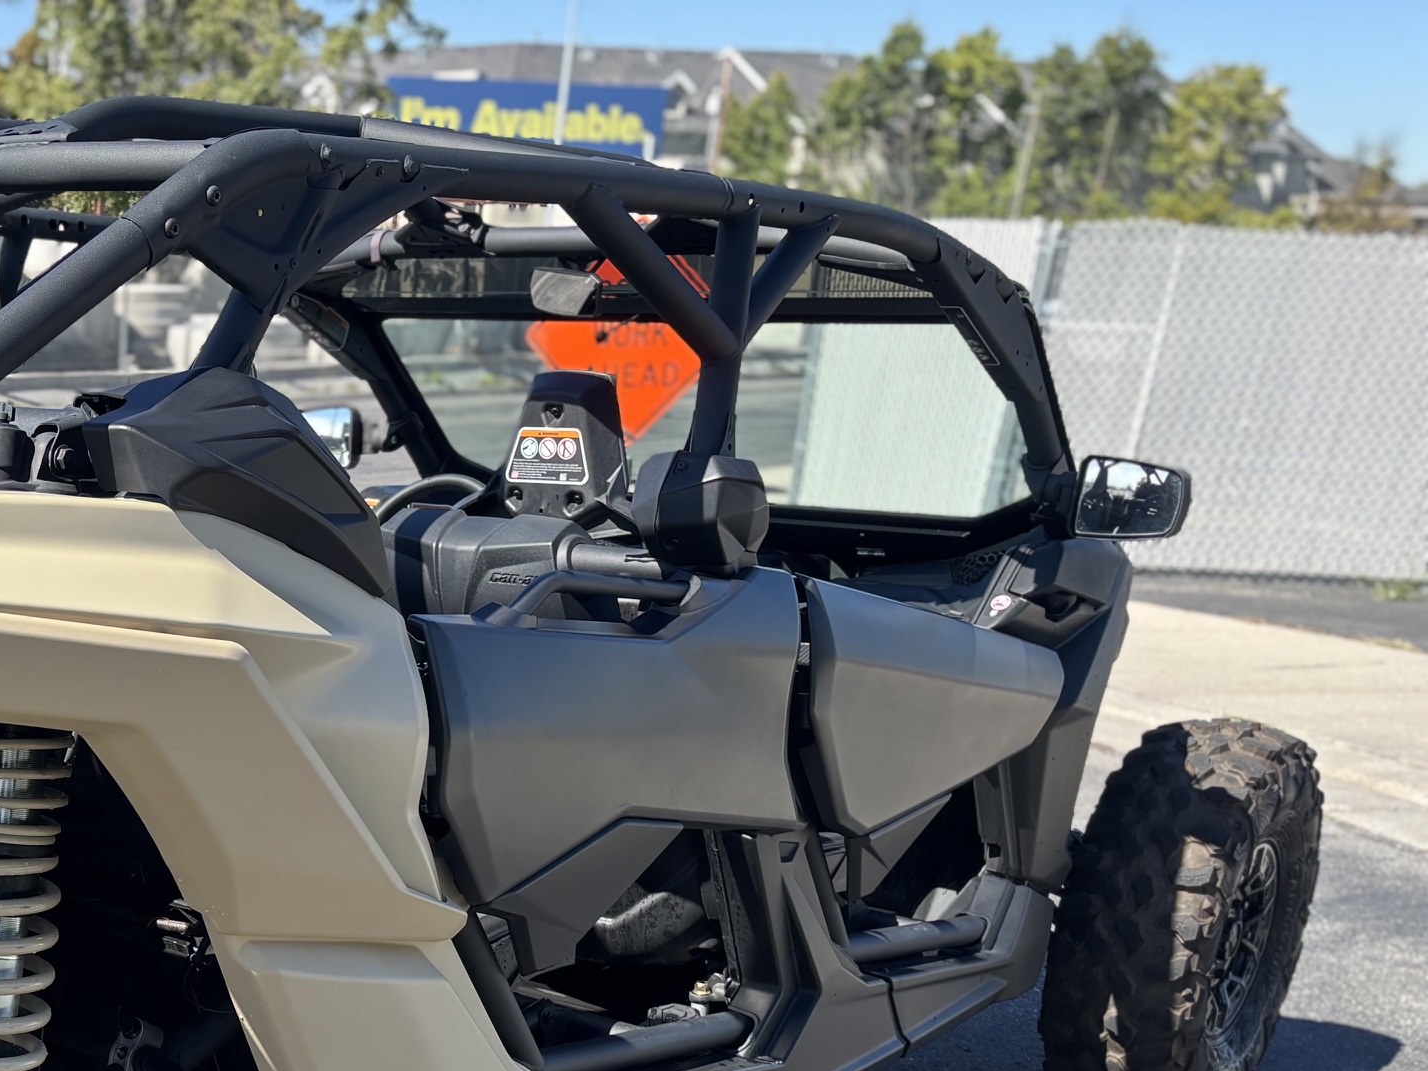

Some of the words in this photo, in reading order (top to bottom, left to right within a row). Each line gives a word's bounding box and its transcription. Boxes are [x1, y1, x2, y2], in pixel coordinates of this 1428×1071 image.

[400, 97, 460, 130] I'm
[587, 361, 679, 388] EAD
[489, 572, 538, 586] can-a
